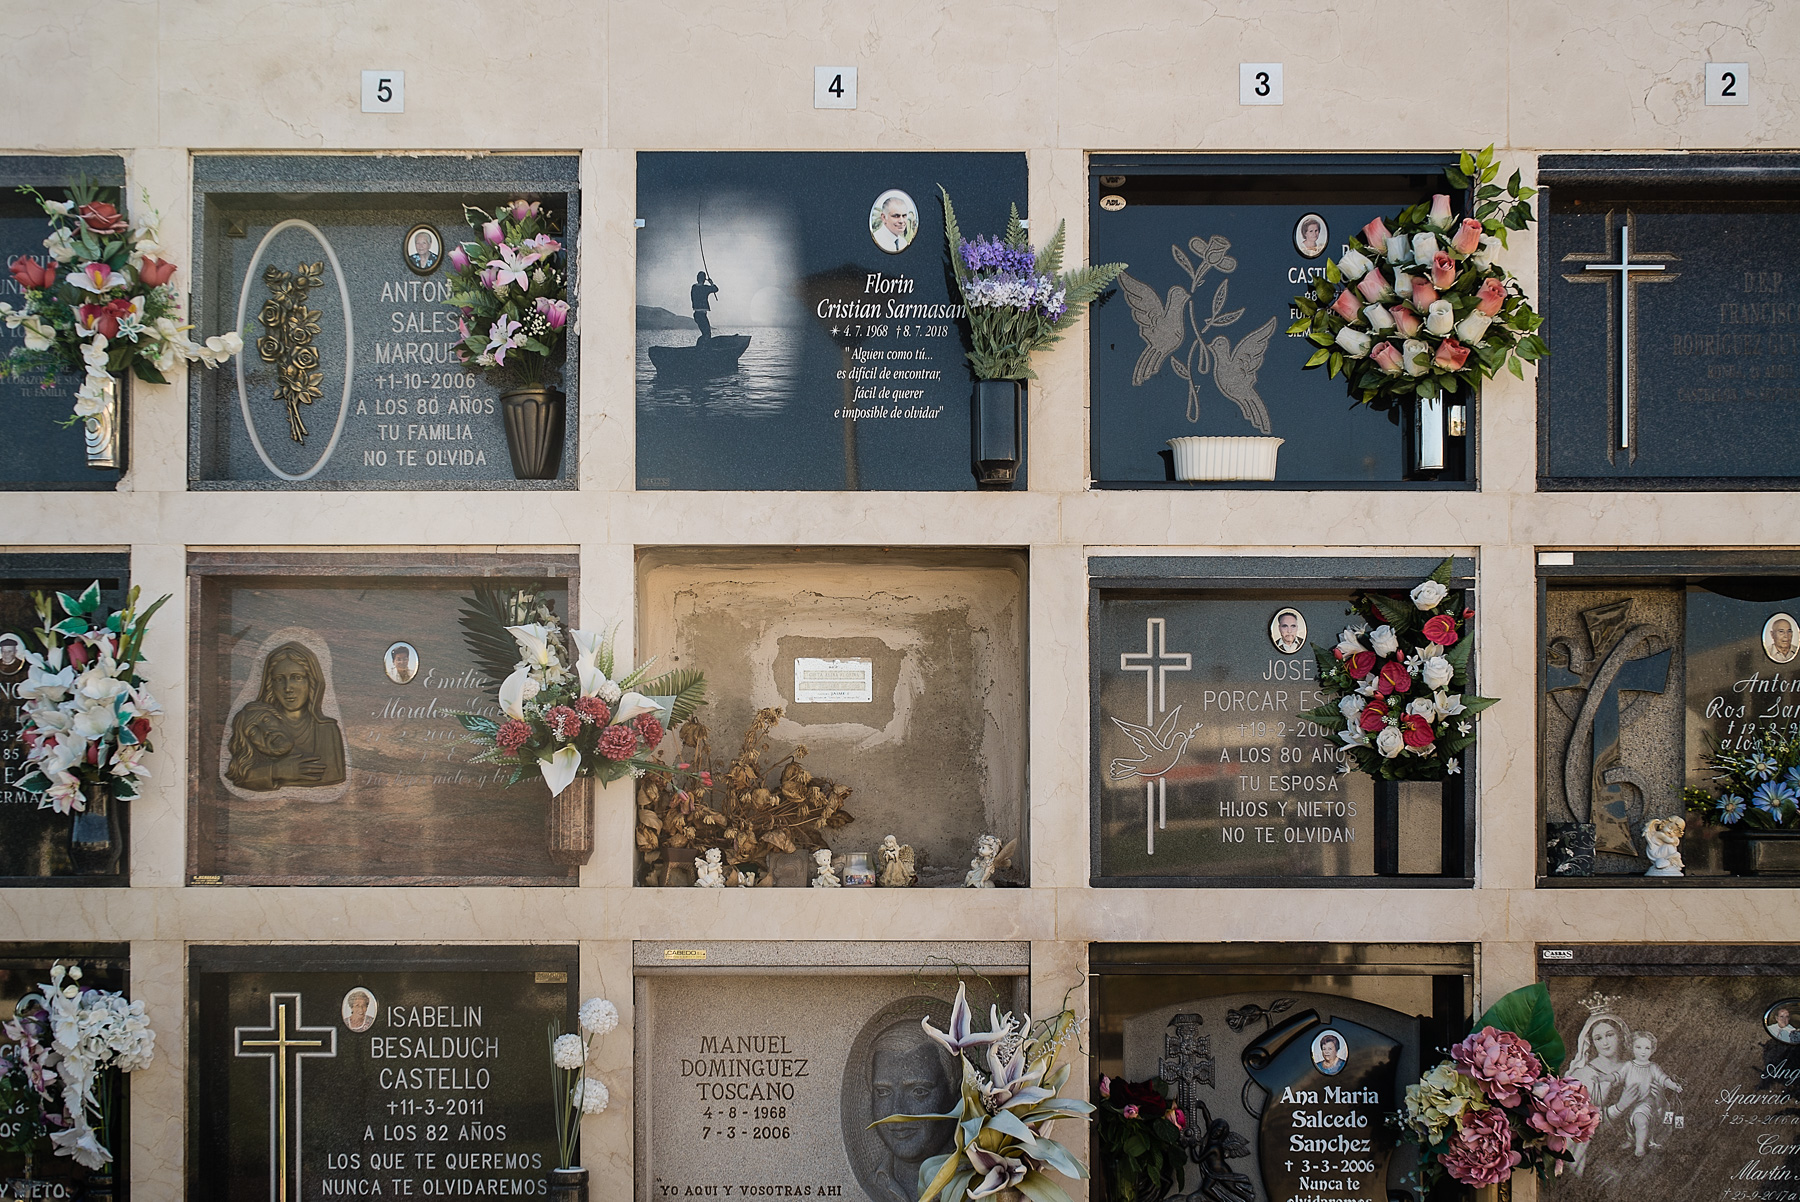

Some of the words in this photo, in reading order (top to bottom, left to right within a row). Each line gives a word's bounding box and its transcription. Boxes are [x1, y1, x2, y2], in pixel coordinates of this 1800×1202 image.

[377, 78, 392, 103] 5
[828, 74, 844, 98] 4
[1254, 71, 1271, 96] 3
[1721, 71, 1737, 96] 2
[380, 281, 456, 303] ANTON
[863, 272, 915, 294] Florin
[816, 298, 882, 319] Cristian
[885, 298, 967, 319] Sarmasan
[391, 311, 460, 333] SALES
[375, 342, 461, 365] MARQUE
[1672, 333, 1761, 356] RODRIGUEZ
[886, 350, 913, 360] como
[836, 369, 847, 380] es
[848, 367, 877, 382] difícil
[878, 367, 891, 380] de
[893, 368, 942, 382] encontrar,
[852, 386, 877, 403] fácil
[878, 386, 891, 399] de
[892, 388, 924, 403] querer
[356, 399, 367, 415] A
[376, 399, 408, 416] LOS
[416, 399, 439, 416] 80
[448, 395, 495, 416] AÑOS
[834, 408, 840, 419] e
[842, 405, 888, 421] imposible
[890, 405, 903, 419] de
[904, 405, 944, 419] olvidar"
[378, 424, 400, 440] TU
[408, 424, 473, 441] FAMILIA
[364, 450, 387, 466] NO
[396, 450, 417, 466] TE
[426, 450, 487, 466] OLVIDA
[1262, 659, 1314, 681] JOSE
[1203, 690, 1288, 712] PORCAR
[1705, 696, 1746, 719] Ros
[3, 748, 19, 760] 85
[1219, 747, 1231, 763] A
[1239, 747, 1271, 763] LOS
[1280, 747, 1302, 763] 80
[1311, 743, 1358, 763] AÑOS
[1721, 738, 1732, 750] a
[1239, 775, 1260, 791] TU
[1269, 775, 1338, 792] ESPOSA
[1219, 801, 1268, 817] HIJOS
[1277, 801, 1288, 817] Y
[1297, 801, 1358, 817] NIETOS
[1222, 827, 1245, 843] NO
[1255, 827, 1275, 843] TE
[1284, 827, 1356, 843] OLVIDAN
[387, 1006, 483, 1028] ISABELIN
[370, 1037, 499, 1059] BESALDUCH
[699, 1035, 793, 1054] MANUEL
[681, 1059, 810, 1077] DOMINGUEZ
[379, 1068, 491, 1090] CASTELLO
[696, 1082, 795, 1101] TOSCANO
[1280, 1086, 1319, 1105] Ana
[1323, 1085, 1379, 1104] Maria
[1714, 1084, 1791, 1112] Aparicio
[1291, 1109, 1368, 1128] Salcedo
[363, 1125, 375, 1141] A
[384, 1125, 417, 1141] LOS
[426, 1125, 449, 1141] 82
[458, 1121, 507, 1141] AÑOS
[1289, 1133, 1371, 1155] Sanchez
[327, 1153, 361, 1170] LOS
[370, 1153, 405, 1171] QUE
[415, 1153, 436, 1170] TE
[445, 1153, 542, 1171] QUEREMOS
[1730, 1159, 1792, 1181] Martín
[322, 1179, 382, 1196] NUNCA
[392, 1179, 413, 1196] TE
[422, 1179, 548, 1196] OLVIDAREMOS
[684, 1185, 718, 1196] AQUI
[723, 1185, 733, 1196] Y
[739, 1185, 811, 1197] VOSOTRAS
[818, 1185, 842, 1196] AHI
[1299, 1176, 1343, 1191] Nunca
[1346, 1177, 1360, 1191] te
